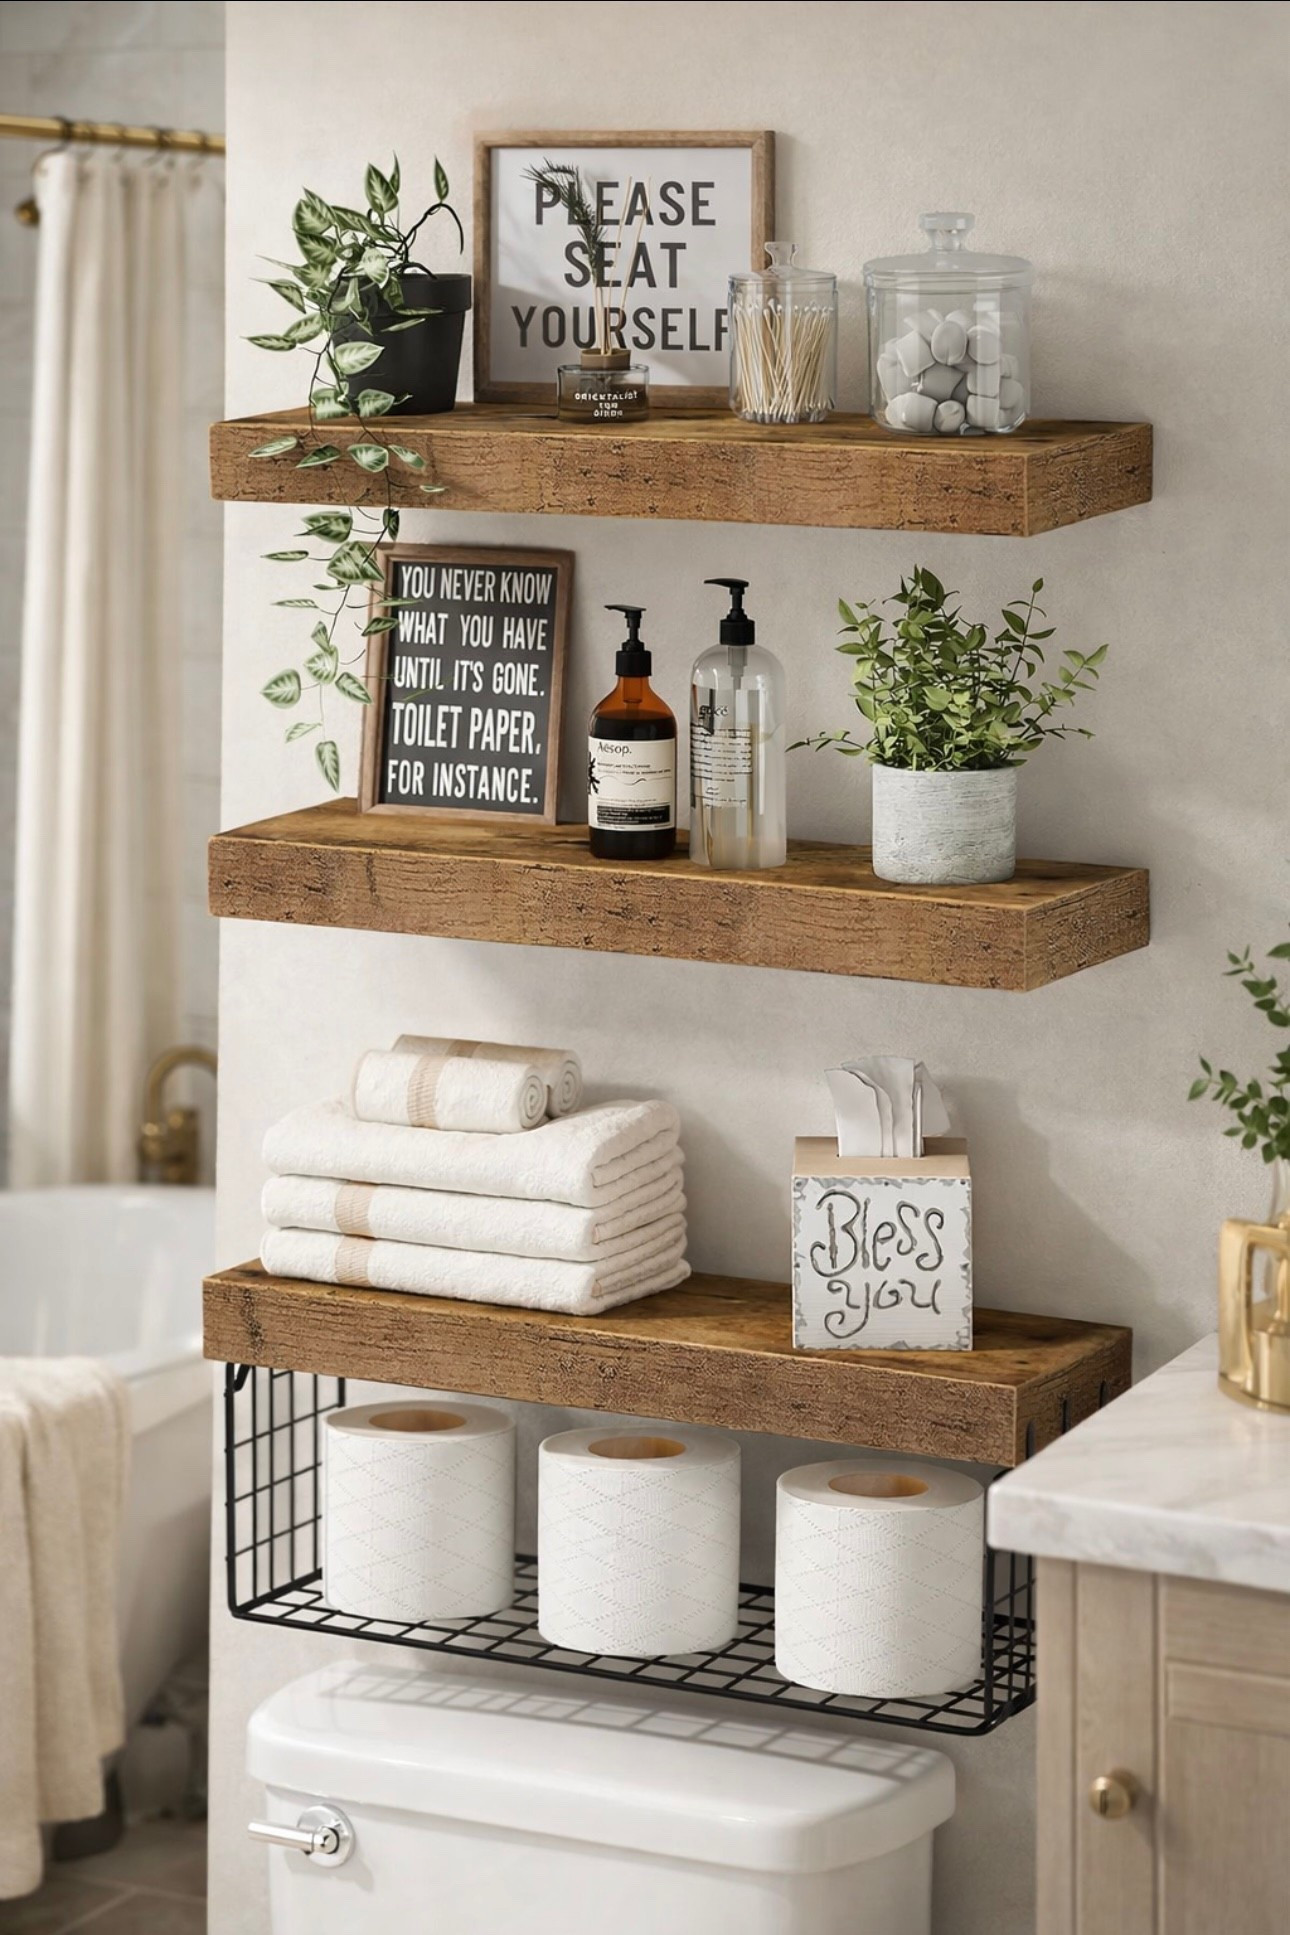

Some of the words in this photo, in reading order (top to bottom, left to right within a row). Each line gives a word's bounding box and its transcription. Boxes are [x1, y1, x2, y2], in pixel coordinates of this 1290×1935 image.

[534, 181, 716, 226] PLEASE
[564, 241, 687, 288] SEAT
[401, 565, 436, 599] YOU
[440, 568, 496, 602] NEVER
[499, 571, 553, 605] KNOW
[397, 610, 448, 645] WHAT
[460, 615, 494, 648] YOU
[502, 617, 548, 651] HAVE
[393, 656, 444, 691] UNTIL
[453, 659, 485, 693] IT'S
[492, 662, 545, 697] GONE.
[392, 702, 463, 749] TOILET
[387, 759, 425, 795] FOR
[432, 762, 539, 804] INSTANCE.
